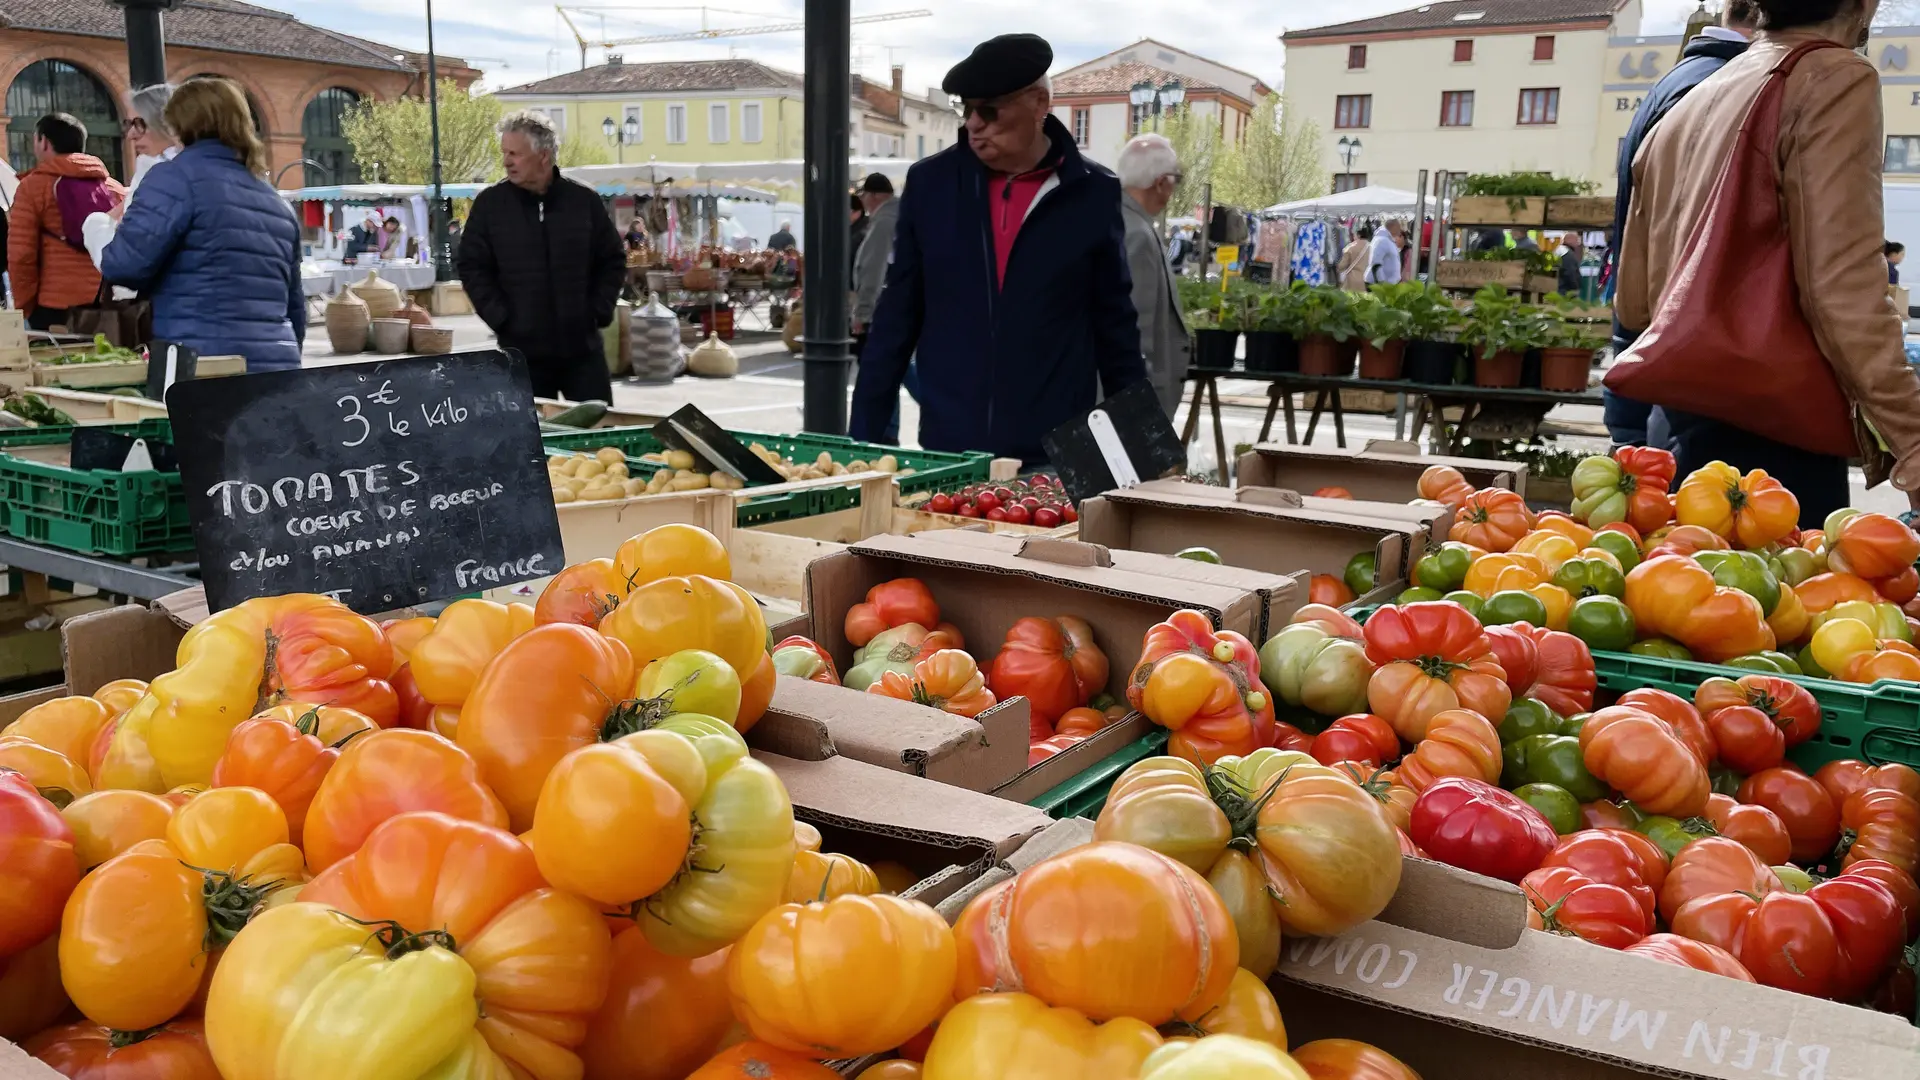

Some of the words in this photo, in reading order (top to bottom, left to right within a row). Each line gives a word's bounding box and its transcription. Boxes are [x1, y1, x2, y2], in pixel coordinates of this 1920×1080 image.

[206, 460, 420, 518] TOMATES
[286, 509, 364, 537] COEUR
[377, 499, 417, 521] DE
[429, 482, 503, 512] BOEUF
[1442, 962, 1668, 1051] MANGER
[1682, 1018, 1831, 1080] BIEN
